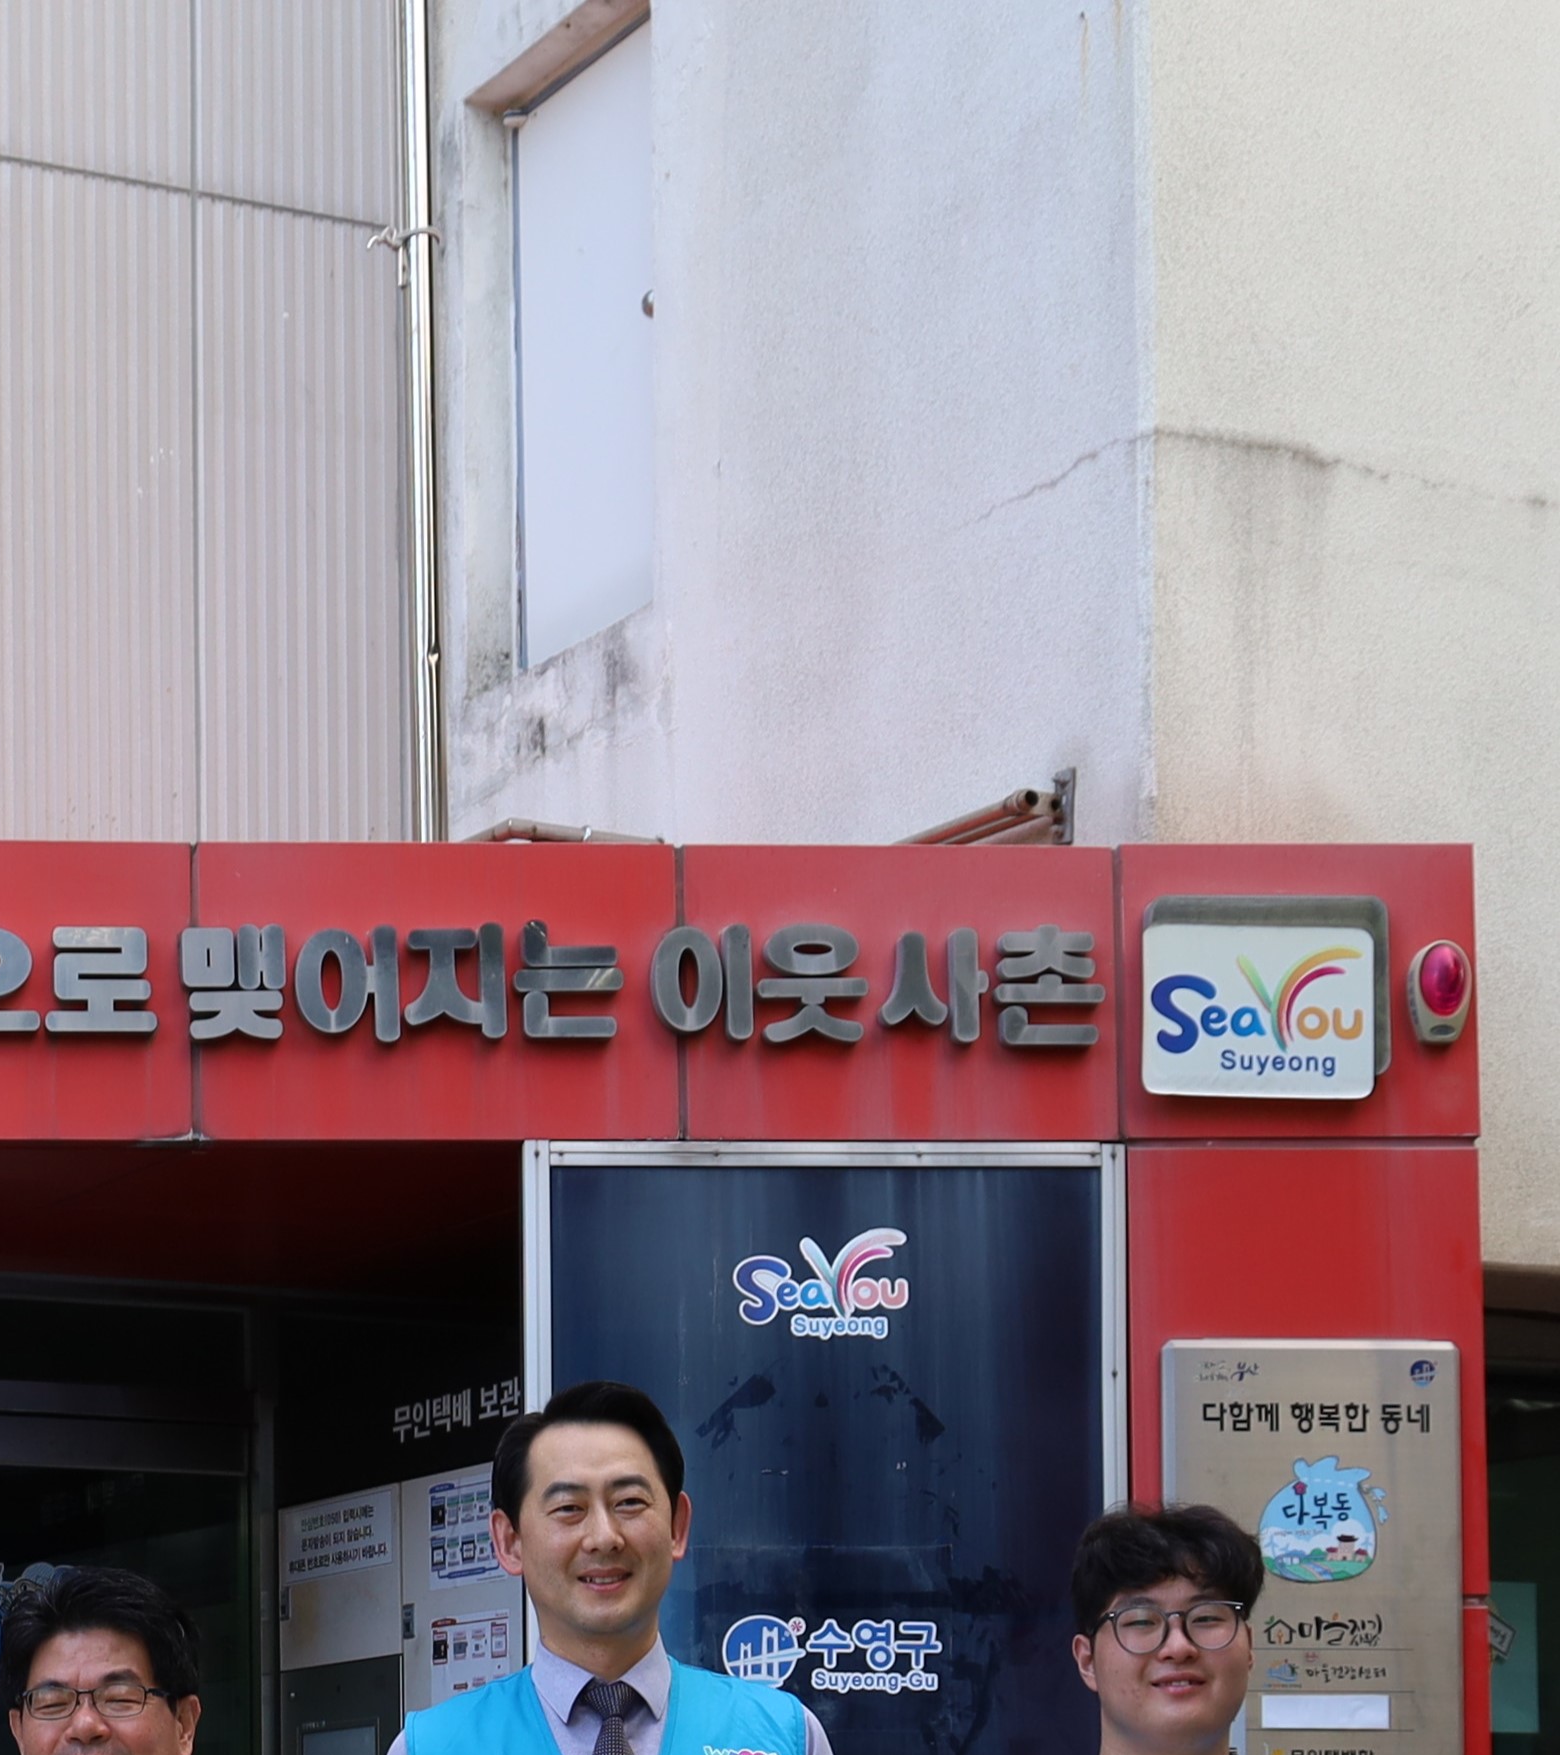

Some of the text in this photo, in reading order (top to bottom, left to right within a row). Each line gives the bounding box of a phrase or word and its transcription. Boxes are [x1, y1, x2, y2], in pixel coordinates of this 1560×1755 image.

[178, 919, 625, 1043] 맺어지는
[649, 920, 1109, 1049] 이웃사촌
[1218, 1046, 1339, 1080] Suyeong
[790, 1313, 889, 1340] Suyeong
[392, 1377, 522, 1443] 무인택배 보관
[1202, 1402, 1431, 1434] 다함께 행복한 동네
[1281, 1491, 1353, 1530] 다복동
[805, 1617, 942, 1671] 수영구
[811, 1668, 940, 1695] Suyeong-Gu
